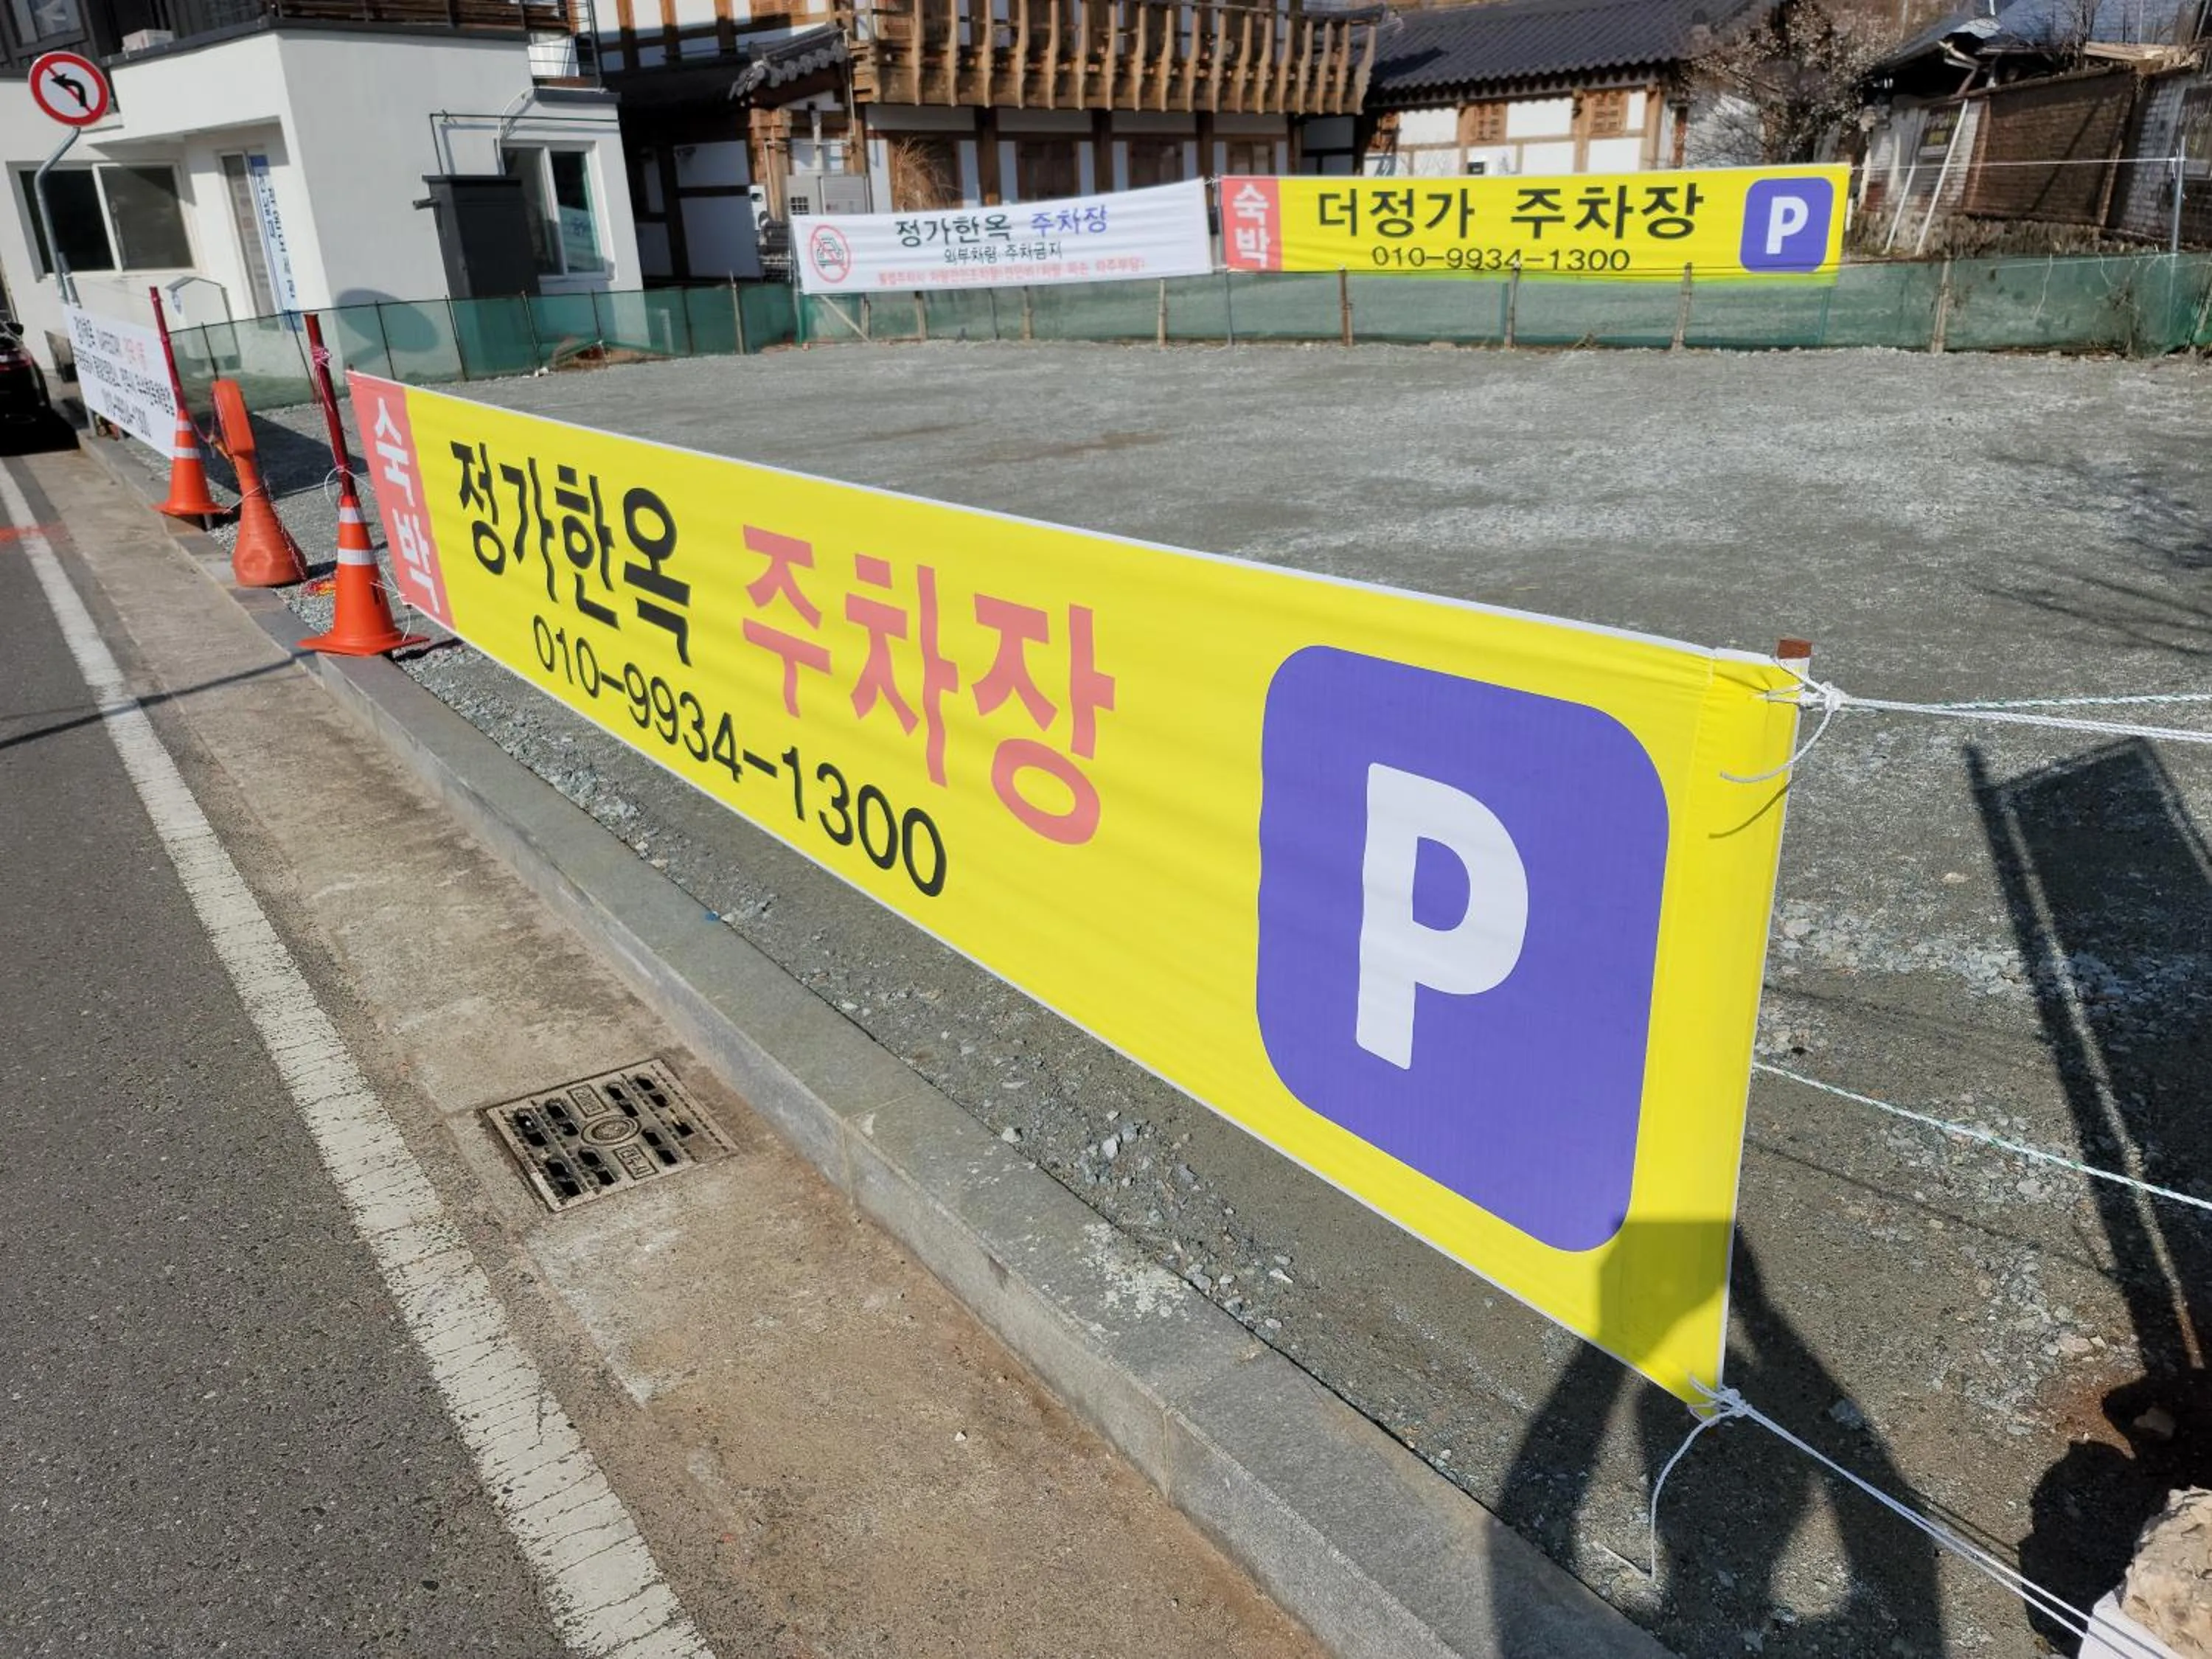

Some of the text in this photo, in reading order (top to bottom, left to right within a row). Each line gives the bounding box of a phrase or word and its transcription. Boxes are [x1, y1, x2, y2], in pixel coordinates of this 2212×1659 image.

[895, 204, 1108, 248] 정가한옥 주차장
[1231, 183, 1269, 268] 숙박
[1319, 181, 1705, 239] 더정가 주차장
[1766, 196, 1809, 254] P
[1005, 242, 1062, 262] 주차금지
[1372, 246, 1631, 271] 010-9934-1300
[372, 397, 439, 614] 숙박
[450, 441, 1116, 846] 정가한옥 주차장
[532, 614, 947, 897] 010-9934-1300
[1354, 762, 1531, 1071] P
